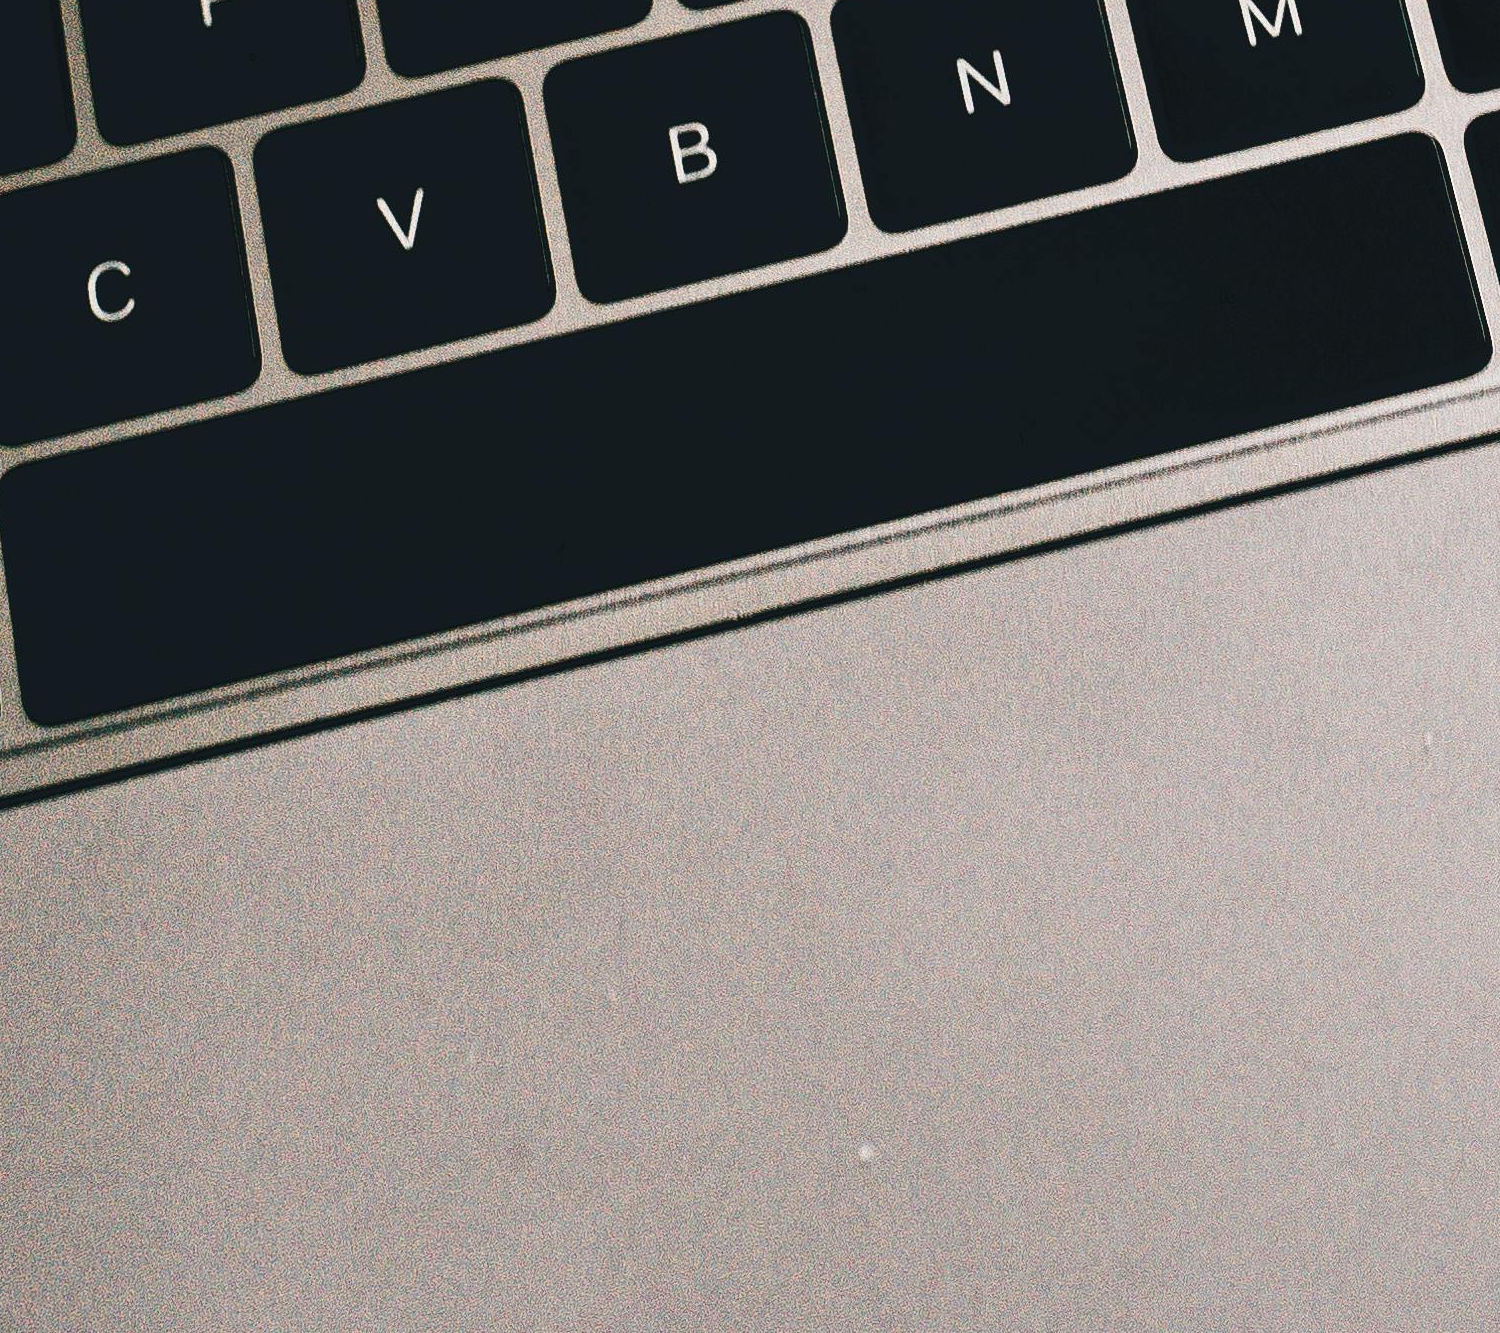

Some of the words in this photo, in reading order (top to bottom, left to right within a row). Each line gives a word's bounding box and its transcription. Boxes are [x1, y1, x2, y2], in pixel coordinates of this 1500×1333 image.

[956, 49, 1012, 114] N
[668, 122, 718, 184] B
[376, 188, 424, 250] V
[87, 261, 135, 322] C
